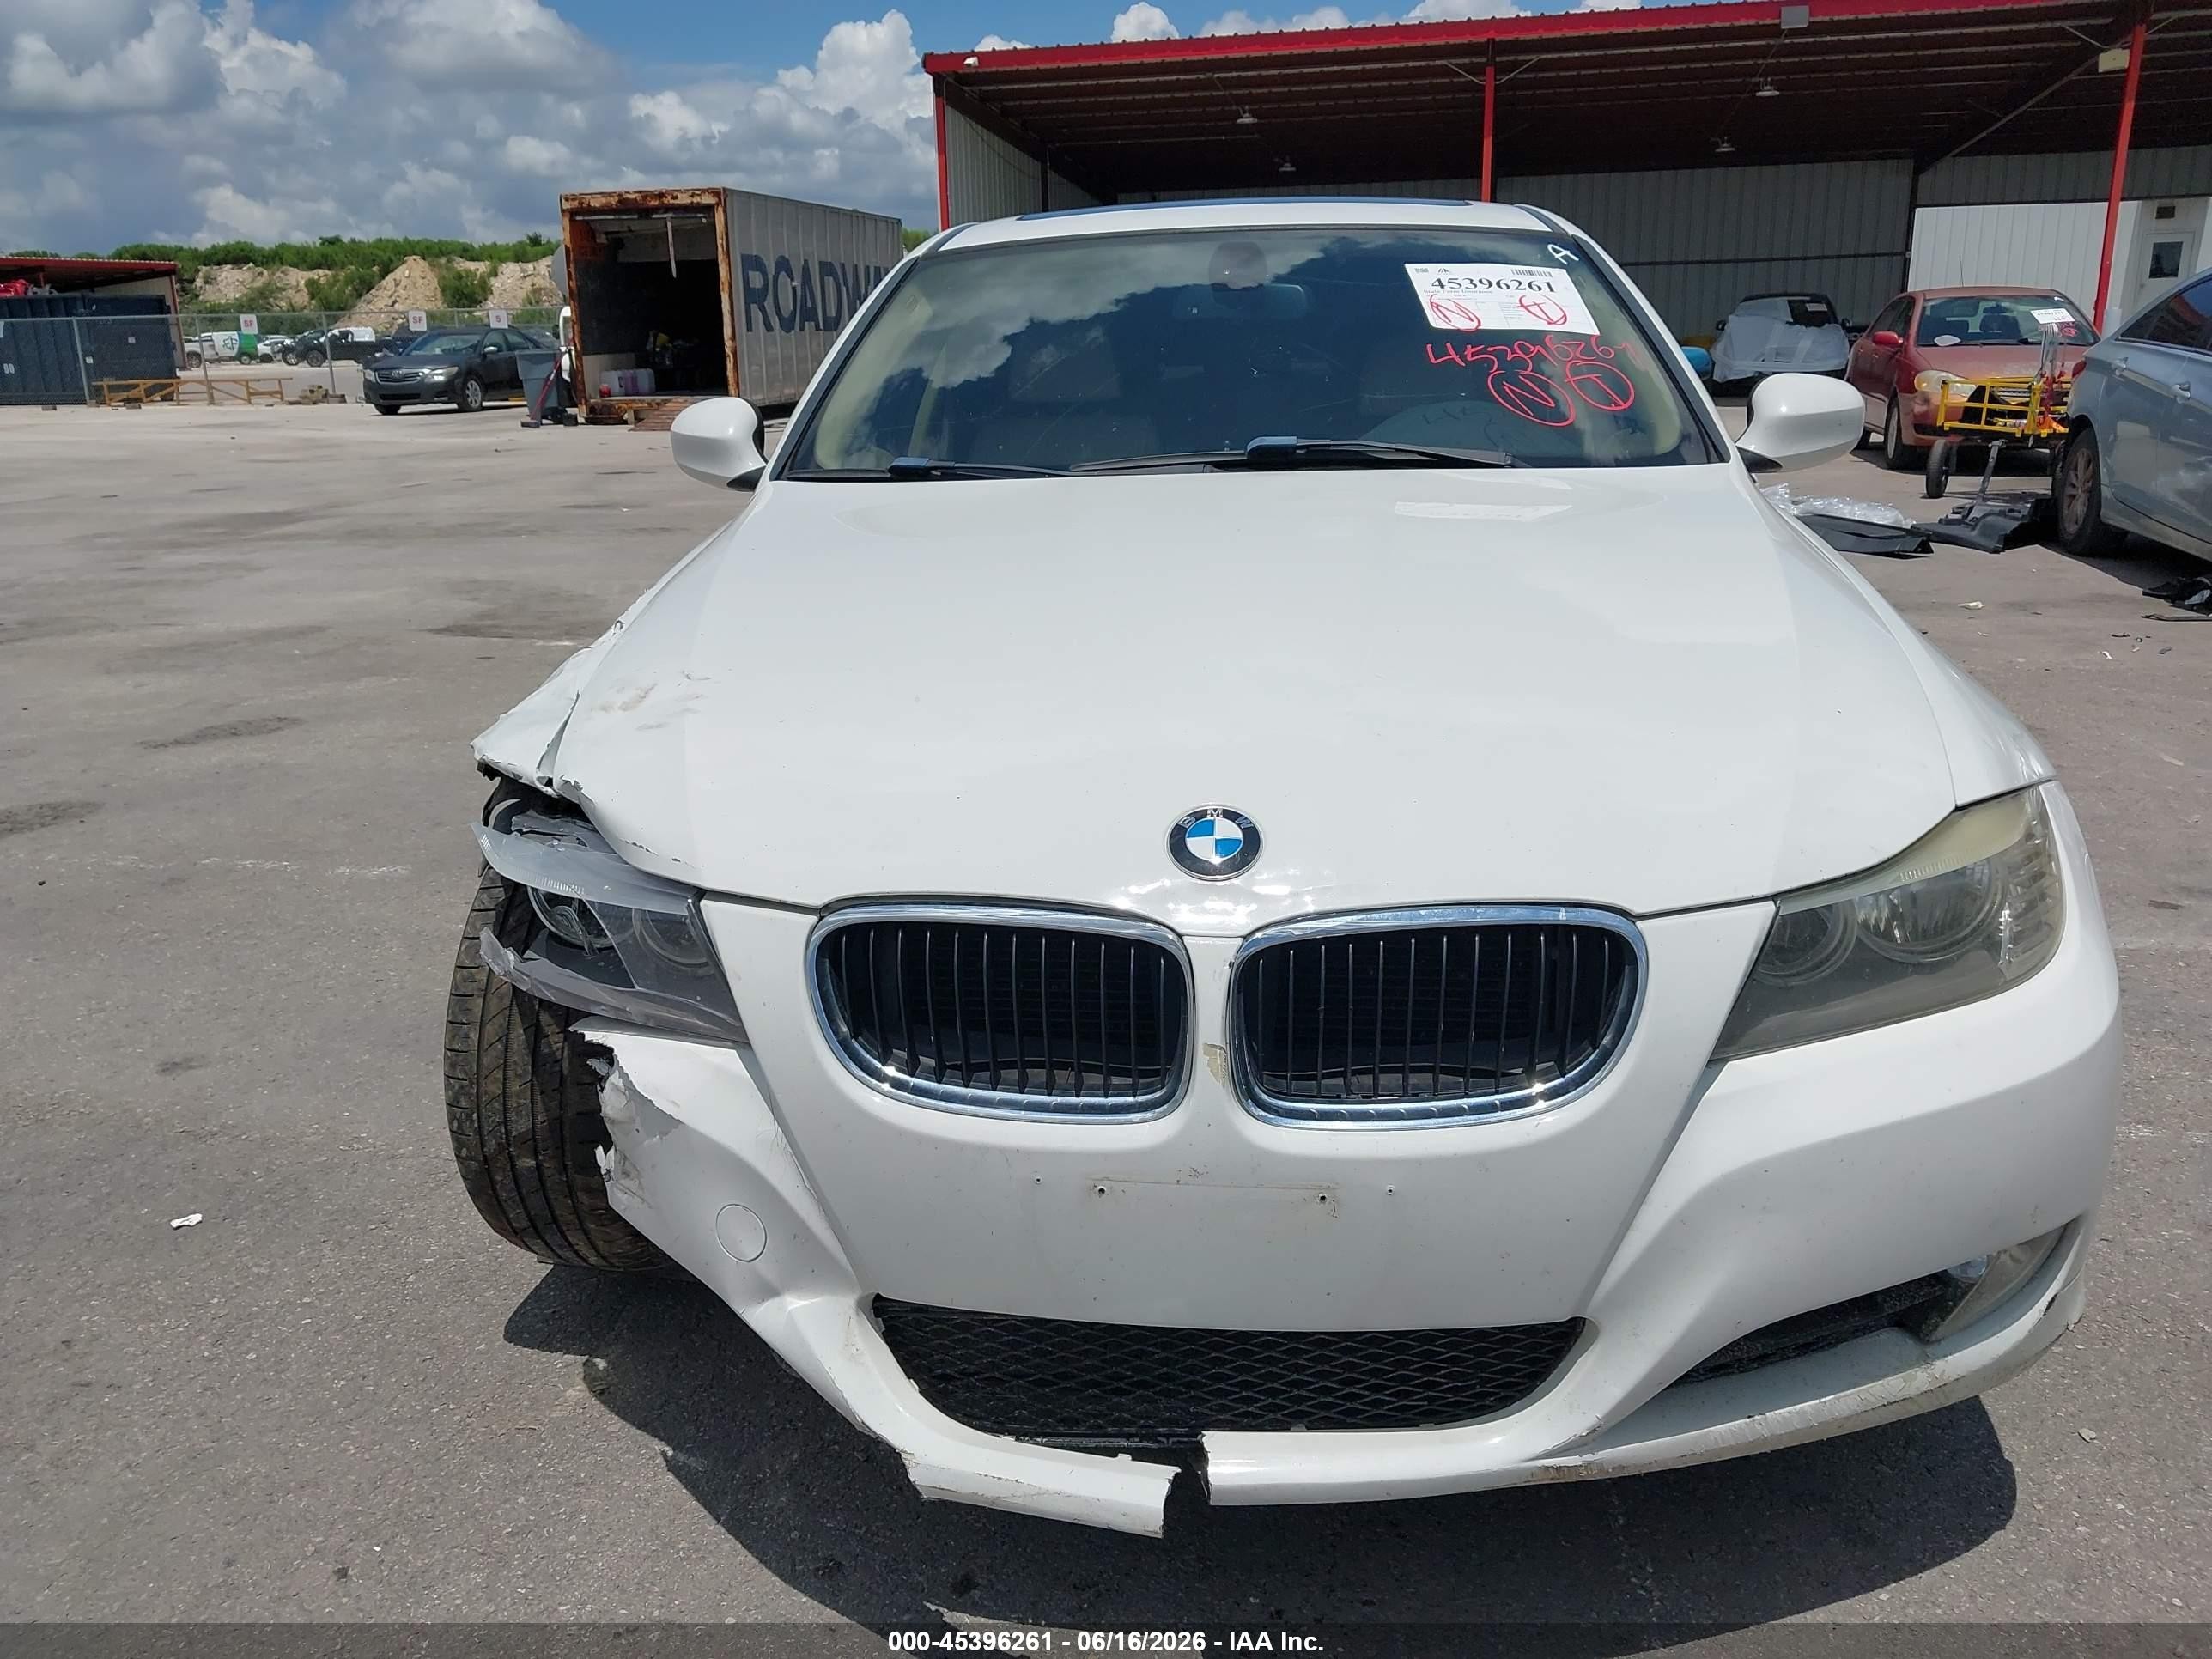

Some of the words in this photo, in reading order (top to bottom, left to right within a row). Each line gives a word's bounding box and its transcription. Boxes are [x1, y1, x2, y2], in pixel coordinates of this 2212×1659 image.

[741, 253, 889, 333] ROADW
[1431, 277, 1555, 293] 45396261
[1178, 808, 1255, 830] BMW
